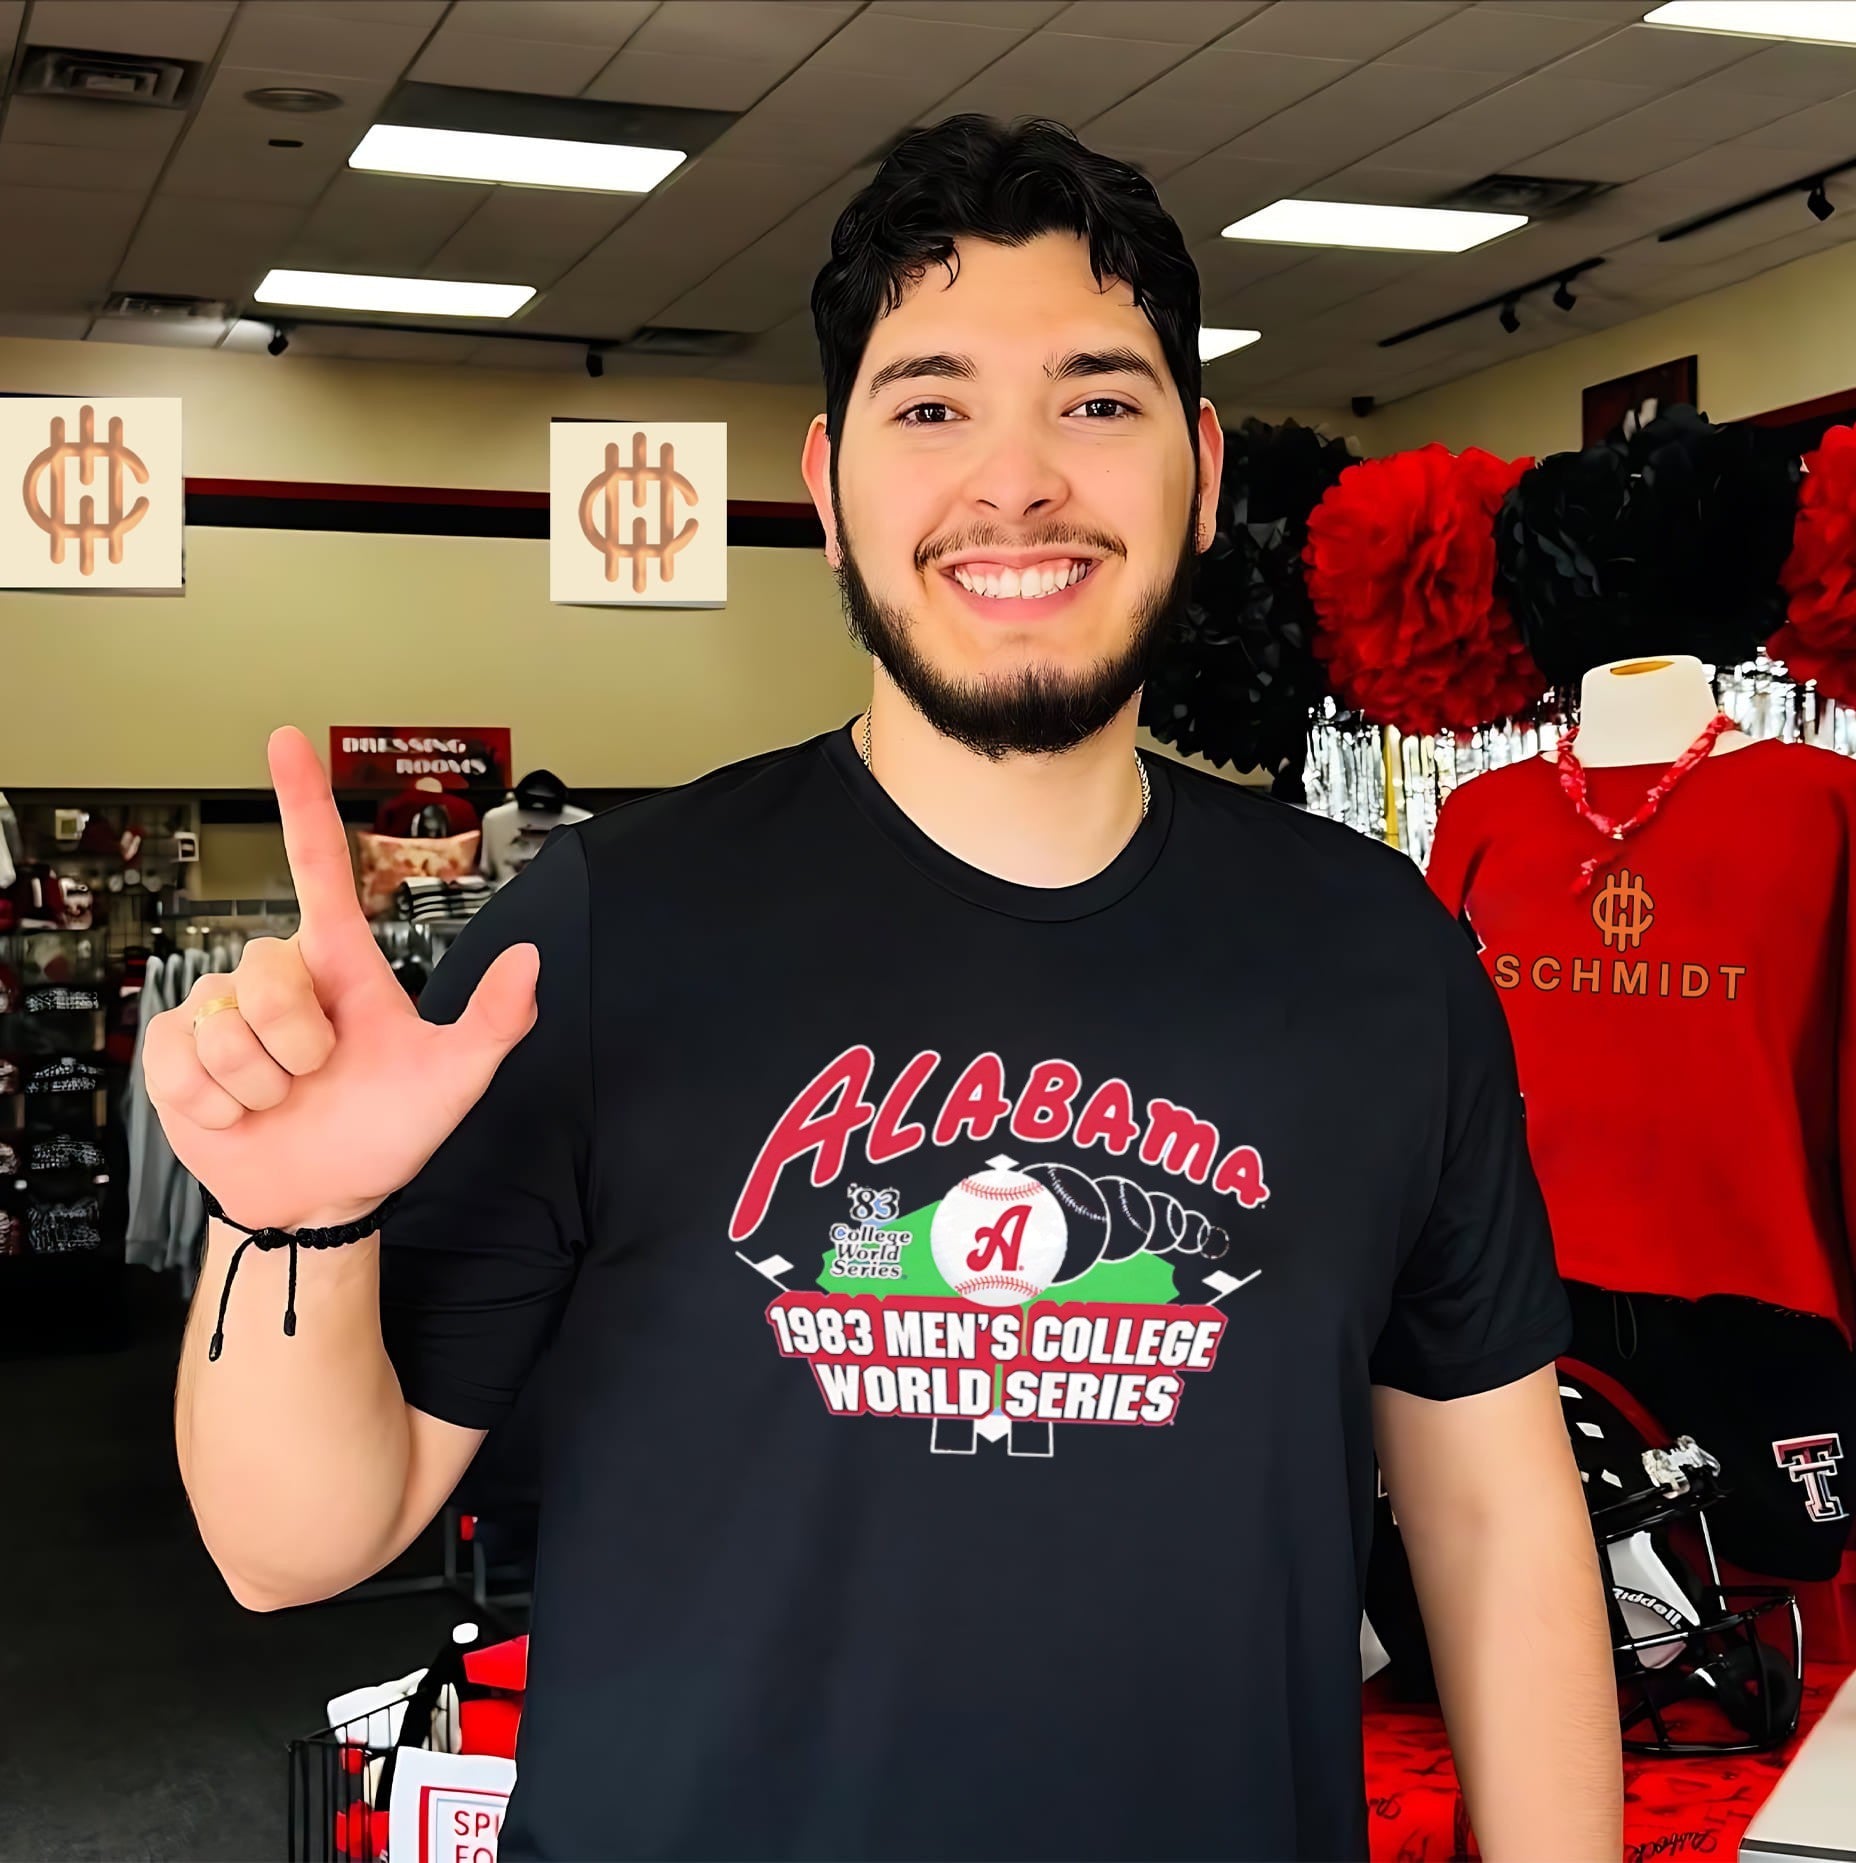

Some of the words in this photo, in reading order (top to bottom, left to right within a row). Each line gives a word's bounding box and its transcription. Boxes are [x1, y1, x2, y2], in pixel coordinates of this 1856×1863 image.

[1494, 954, 1748, 1001] SCHMIDT
[729, 1045, 1270, 1241] ALABAMA
[847, 1183, 900, 1222] '83
[829, 1222, 912, 1246] College
[835, 1241, 901, 1262] World
[966, 1204, 1033, 1272] A
[830, 1259, 903, 1280] Series
[769, 1306, 875, 1357] 1983
[882, 1309, 1021, 1362] MEN'S
[1031, 1315, 1223, 1369] COLLEGE
[814, 1362, 992, 1416] WORLD
[1004, 1369, 1180, 1422] SERIES
